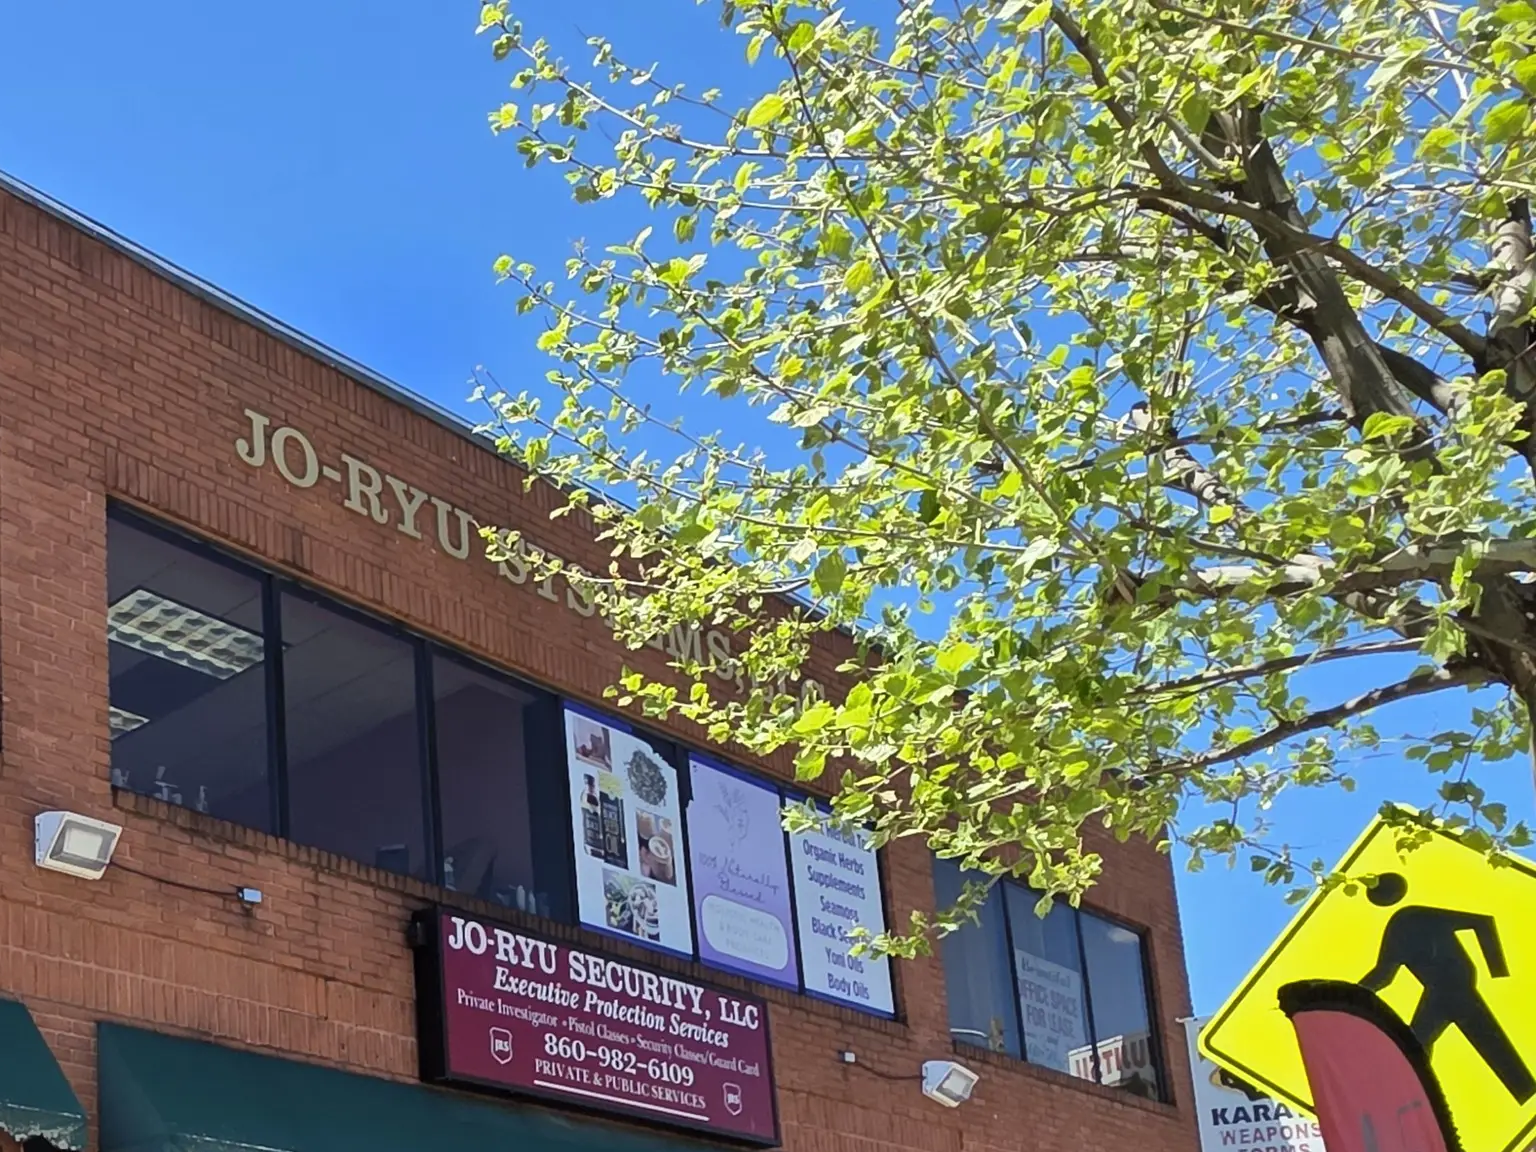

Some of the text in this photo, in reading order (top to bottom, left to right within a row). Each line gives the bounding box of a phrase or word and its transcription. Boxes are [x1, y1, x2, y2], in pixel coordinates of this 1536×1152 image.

[235, 408, 476, 560] JO-RYU
[803, 839, 865, 876] Organic Herbs
[807, 865, 866, 900] Supplements
[812, 916, 837, 940] Black
[449, 917, 759, 1030] JO-RYU SECURITY, LLC
[828, 972, 870, 1000] Body Oils
[494, 966, 729, 1048] Executive Protection Services
[457, 988, 495, 1012] Private
[498, 999, 558, 1027] Investigator
[568, 1016, 595, 1036] Pistol
[597, 1023, 629, 1044] Classes
[636, 1034, 672, 1059] Security
[738, 1061, 760, 1077] Card
[544, 1033, 694, 1086] 860-982-6109
[535, 1058, 706, 1109] PRIVATE & PUBLIC SERVICES
[1211, 1102, 1306, 1127] KARA
[1220, 1122, 1323, 1146] WEAPONS
